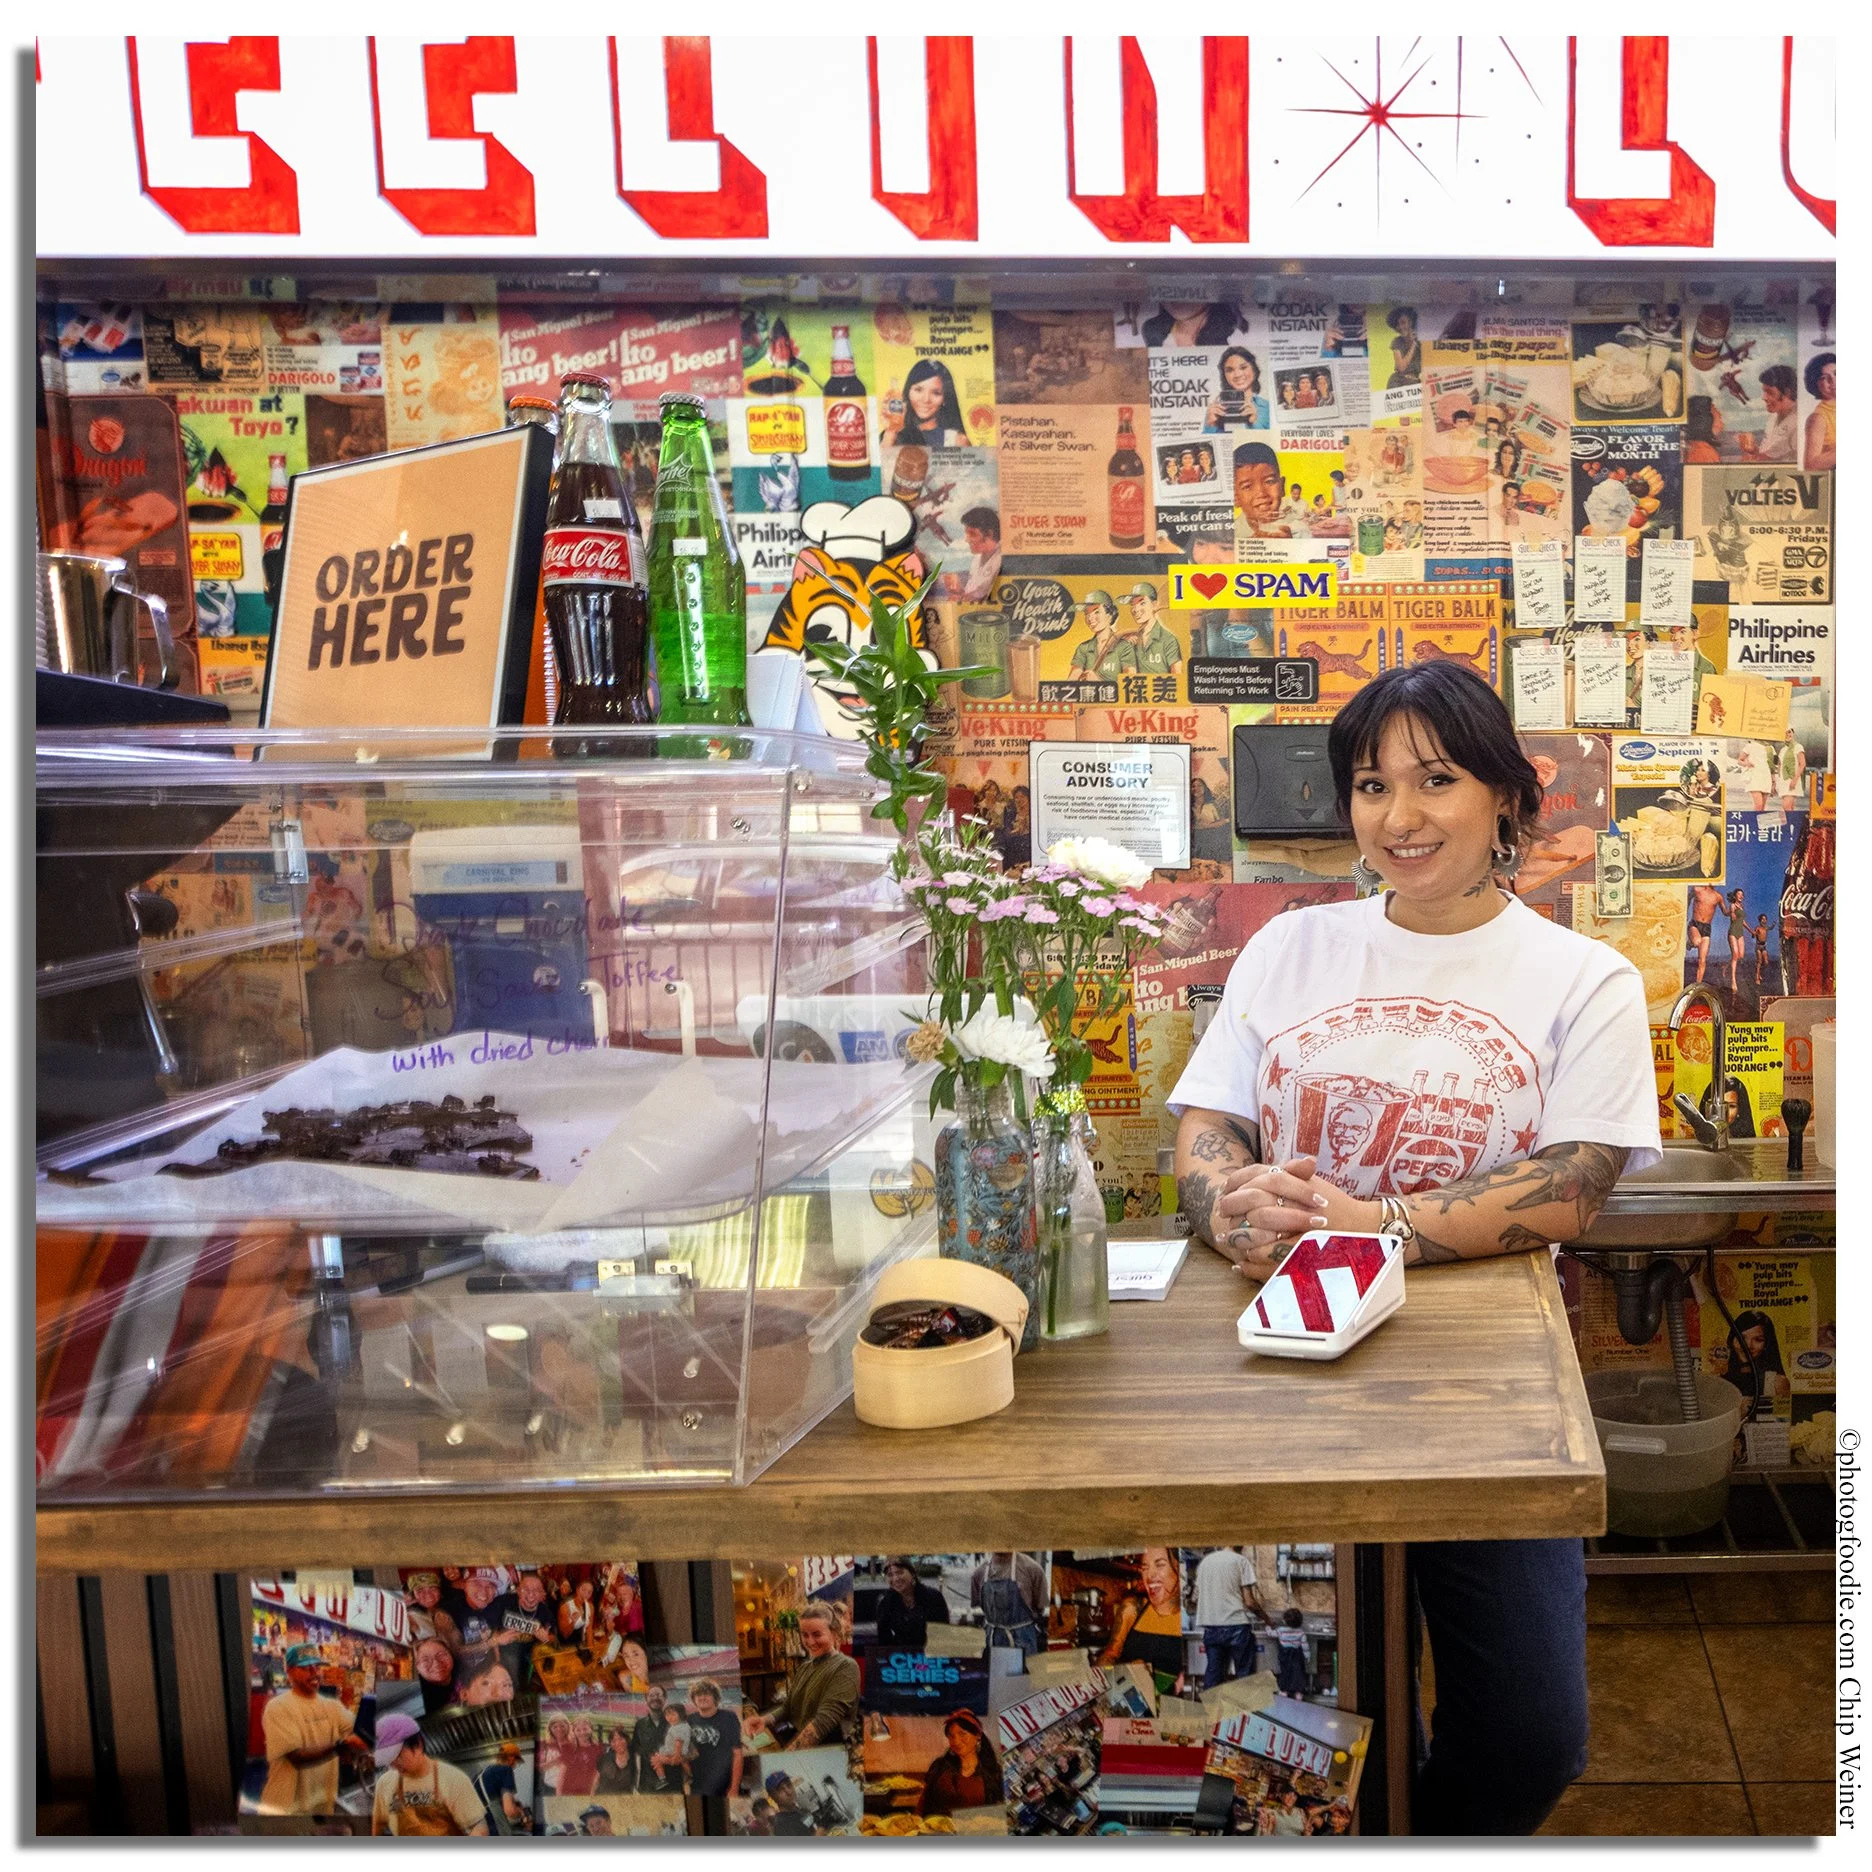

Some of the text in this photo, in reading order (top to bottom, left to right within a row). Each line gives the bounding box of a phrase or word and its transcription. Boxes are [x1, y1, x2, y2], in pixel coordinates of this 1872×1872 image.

[1267, 303, 1328, 318] KODAK
[929, 315, 951, 326] pulp
[1508, 318, 1546, 326] SANTOS
[510, 325, 537, 343] San
[630, 326, 655, 342] San
[930, 335, 957, 346] Royal
[551, 339, 618, 376] beer!
[621, 338, 738, 387] ang beer!
[1171, 356, 1208, 367] HERE!
[267, 372, 336, 385] DARIGOLD
[1149, 369, 1170, 378] THE
[1149, 379, 1209, 394] KODAK
[1150, 395, 1210, 408] INSTANT
[1384, 391, 1404, 400] ANG
[258, 394, 283, 413] at
[1000, 415, 1058, 427] Pistahan.
[1000, 428, 1076, 440] Kasayahan.
[1280, 429, 1335, 438] EVERYBODY LOVES
[1609, 425, 1650, 433] Welcome
[1002, 441, 1096, 451] At Silver Swan.
[1607, 435, 1665, 444] FLAVOR
[1622, 442, 1680, 452] OF THE
[1607, 451, 1660, 460] MONTH
[1725, 474, 1828, 510] VOLTES V
[1010, 515, 1087, 528] SILVER SWAN
[1158, 512, 1189, 523] Peak
[1193, 511, 1204, 522] of
[1175, 523, 1223, 535] you can
[1749, 526, 1829, 534] 6:00-6:30 P.M.
[1787, 534, 1828, 543] Fridays
[543, 537, 622, 571] Coca-Cola
[316, 533, 474, 603] ORDER
[1022, 581, 1061, 599] Your
[1174, 573, 1331, 600] I SPAM
[1013, 597, 1063, 619] Health
[1336, 600, 1385, 619] BALM
[1392, 600, 1450, 620] TIGER
[307, 586, 471, 672] HERE
[1023, 614, 1069, 636] Drink
[1428, 622, 1448, 630] EXTRA
[1449, 622, 1482, 630] STRENGTH
[1728, 619, 1829, 643] Philippine
[1738, 645, 1816, 664] Airlines
[1193, 665, 1260, 676] Employees Must
[1193, 675, 1272, 685] Wash Hands Before
[1193, 686, 1269, 696] Returning To Work
[1280, 705, 1299, 713] PAIN
[973, 739, 1028, 748] PURE VETSIN
[1062, 761, 1153, 775] CONSUMER
[1066, 776, 1149, 789] ADVISORY
[1139, 945, 1239, 976] San Miguel Beer
[588, 950, 684, 998] Toffee
[1754, 1025, 1774, 1034] may
[1727, 1034, 1768, 1045] pulp bits
[392, 1044, 455, 1074] with
[470, 1029, 534, 1065] dried
[1296, 1003, 1528, 1094] AMERICA'S
[1727, 1053, 1753, 1063] Royal
[1097, 1086, 1140, 1095] OINTMENT
[1392, 1158, 1459, 1179] PEPSI
[1779, 1262, 1799, 1271] may
[1753, 1270, 1793, 1280] pulp bits
[1753, 1288, 1779, 1298] Royal
[888, 1652, 950, 1669] CHEF
[881, 1667, 960, 1684] SERIES
[1264, 1723, 1333, 1776] LUCKY
